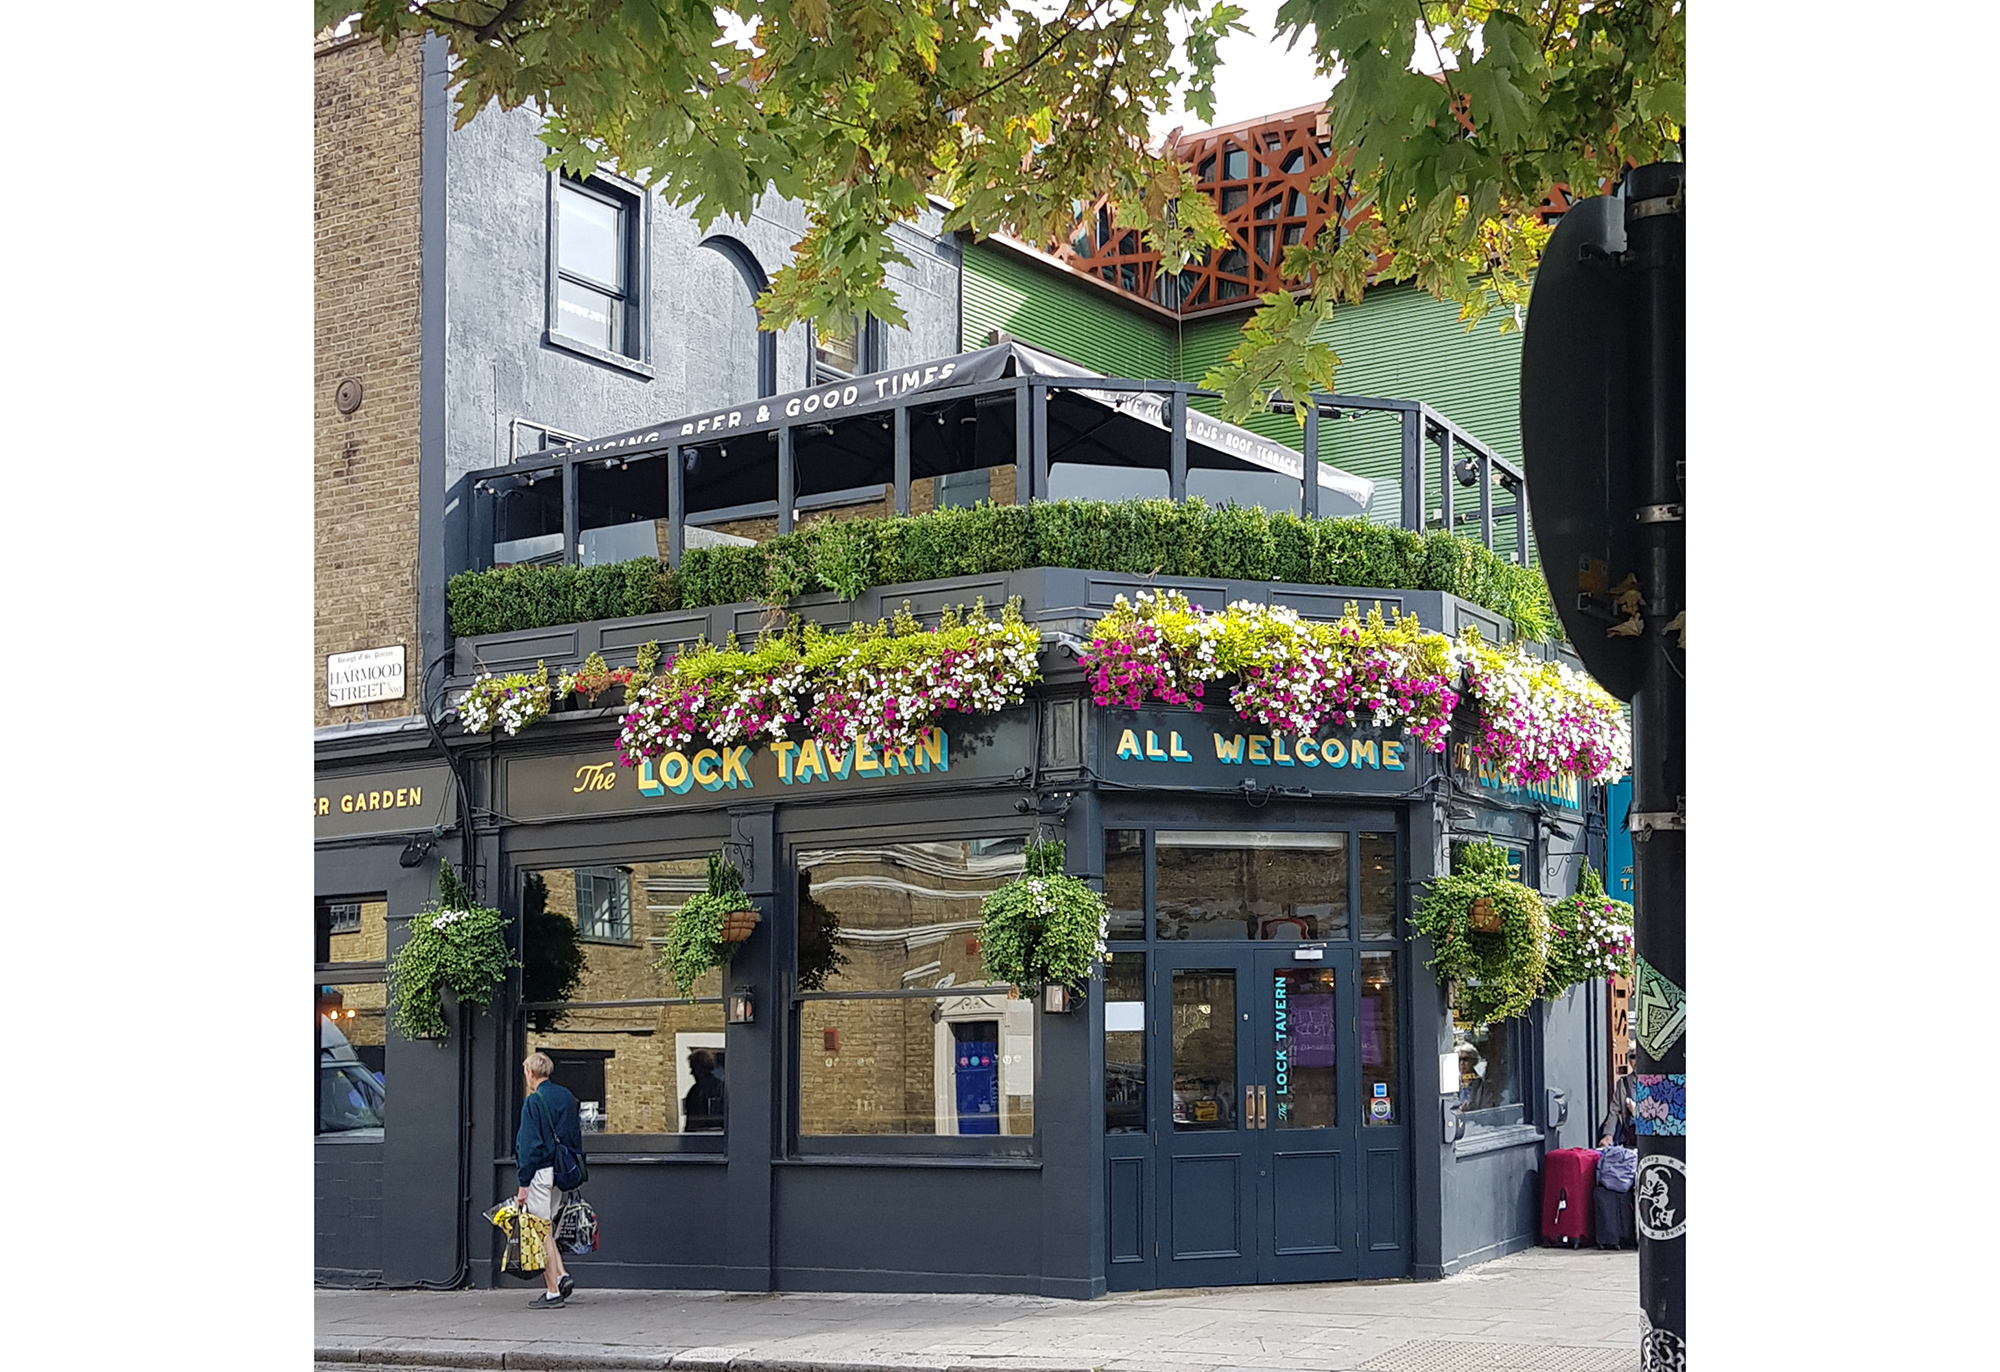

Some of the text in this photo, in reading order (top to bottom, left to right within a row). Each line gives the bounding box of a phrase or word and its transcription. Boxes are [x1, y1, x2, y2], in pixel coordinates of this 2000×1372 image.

[756, 404, 771, 423] &
[785, 386, 858, 417] GOOD
[875, 363, 957, 399] TIMES
[1226, 432, 1253, 453] ROOF
[1256, 444, 1297, 472] TERRACE
[329, 682, 386, 703] STREET
[330, 662, 402, 686] HARMOOD
[573, 727, 949, 798] The LOCK TAVERN
[1116, 729, 1405, 771] ALL WELCOME
[1455, 742, 1471, 772] The
[341, 786, 422, 814] GARDEN
[1274, 976, 1288, 1121] The LOCK TAVERN
